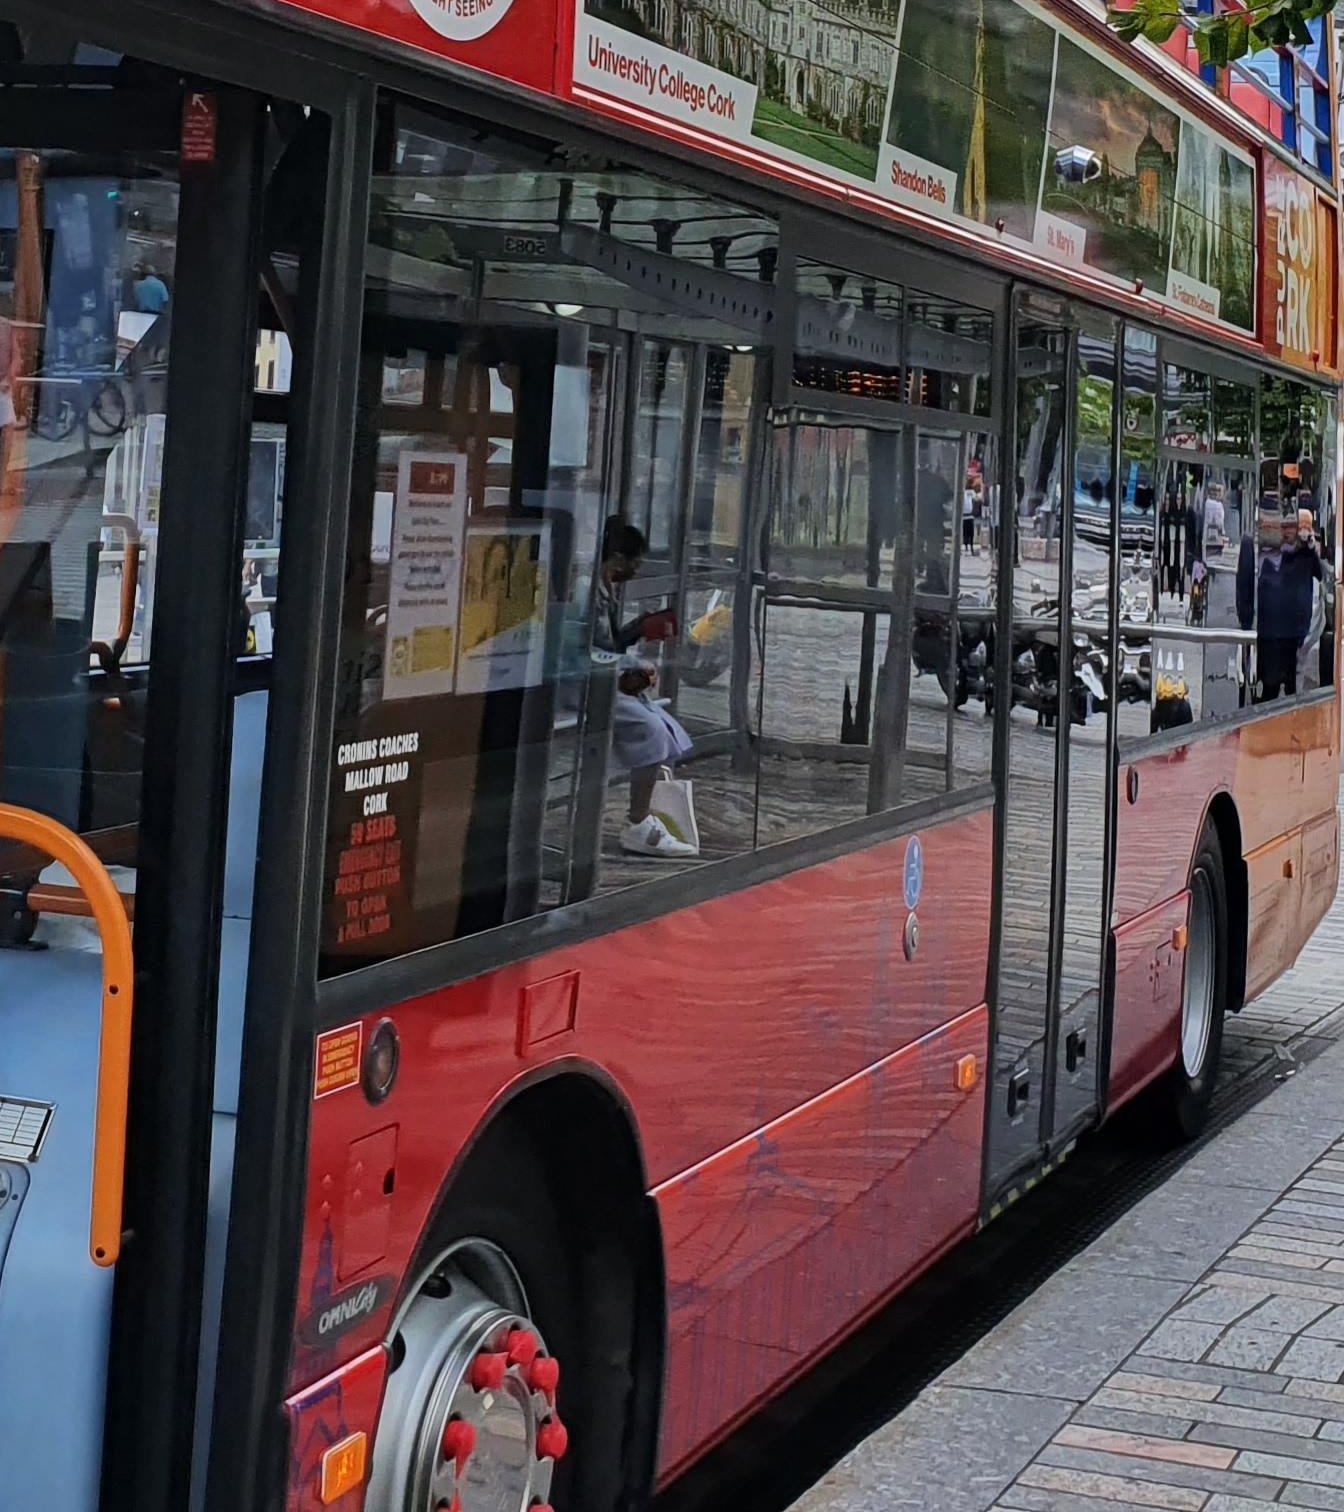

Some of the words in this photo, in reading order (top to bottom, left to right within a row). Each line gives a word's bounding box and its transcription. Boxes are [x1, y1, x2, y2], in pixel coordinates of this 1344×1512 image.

[588, 34, 657, 95] University
[658, 63, 705, 112] College
[707, 83, 736, 121] Cork
[891, 160, 926, 196] Shandon
[927, 175, 946, 204] Bells
[1286, 180, 1313, 270] CO
[1286, 267, 1311, 355] RK
[338, 739, 378, 766] CRONINS
[379, 732, 419, 758] COACHES
[345, 766, 384, 792] MALLOW
[385, 761, 409, 784] ROAD
[363, 792, 388, 816] CORK
[365, 815, 396, 841] SEATS
